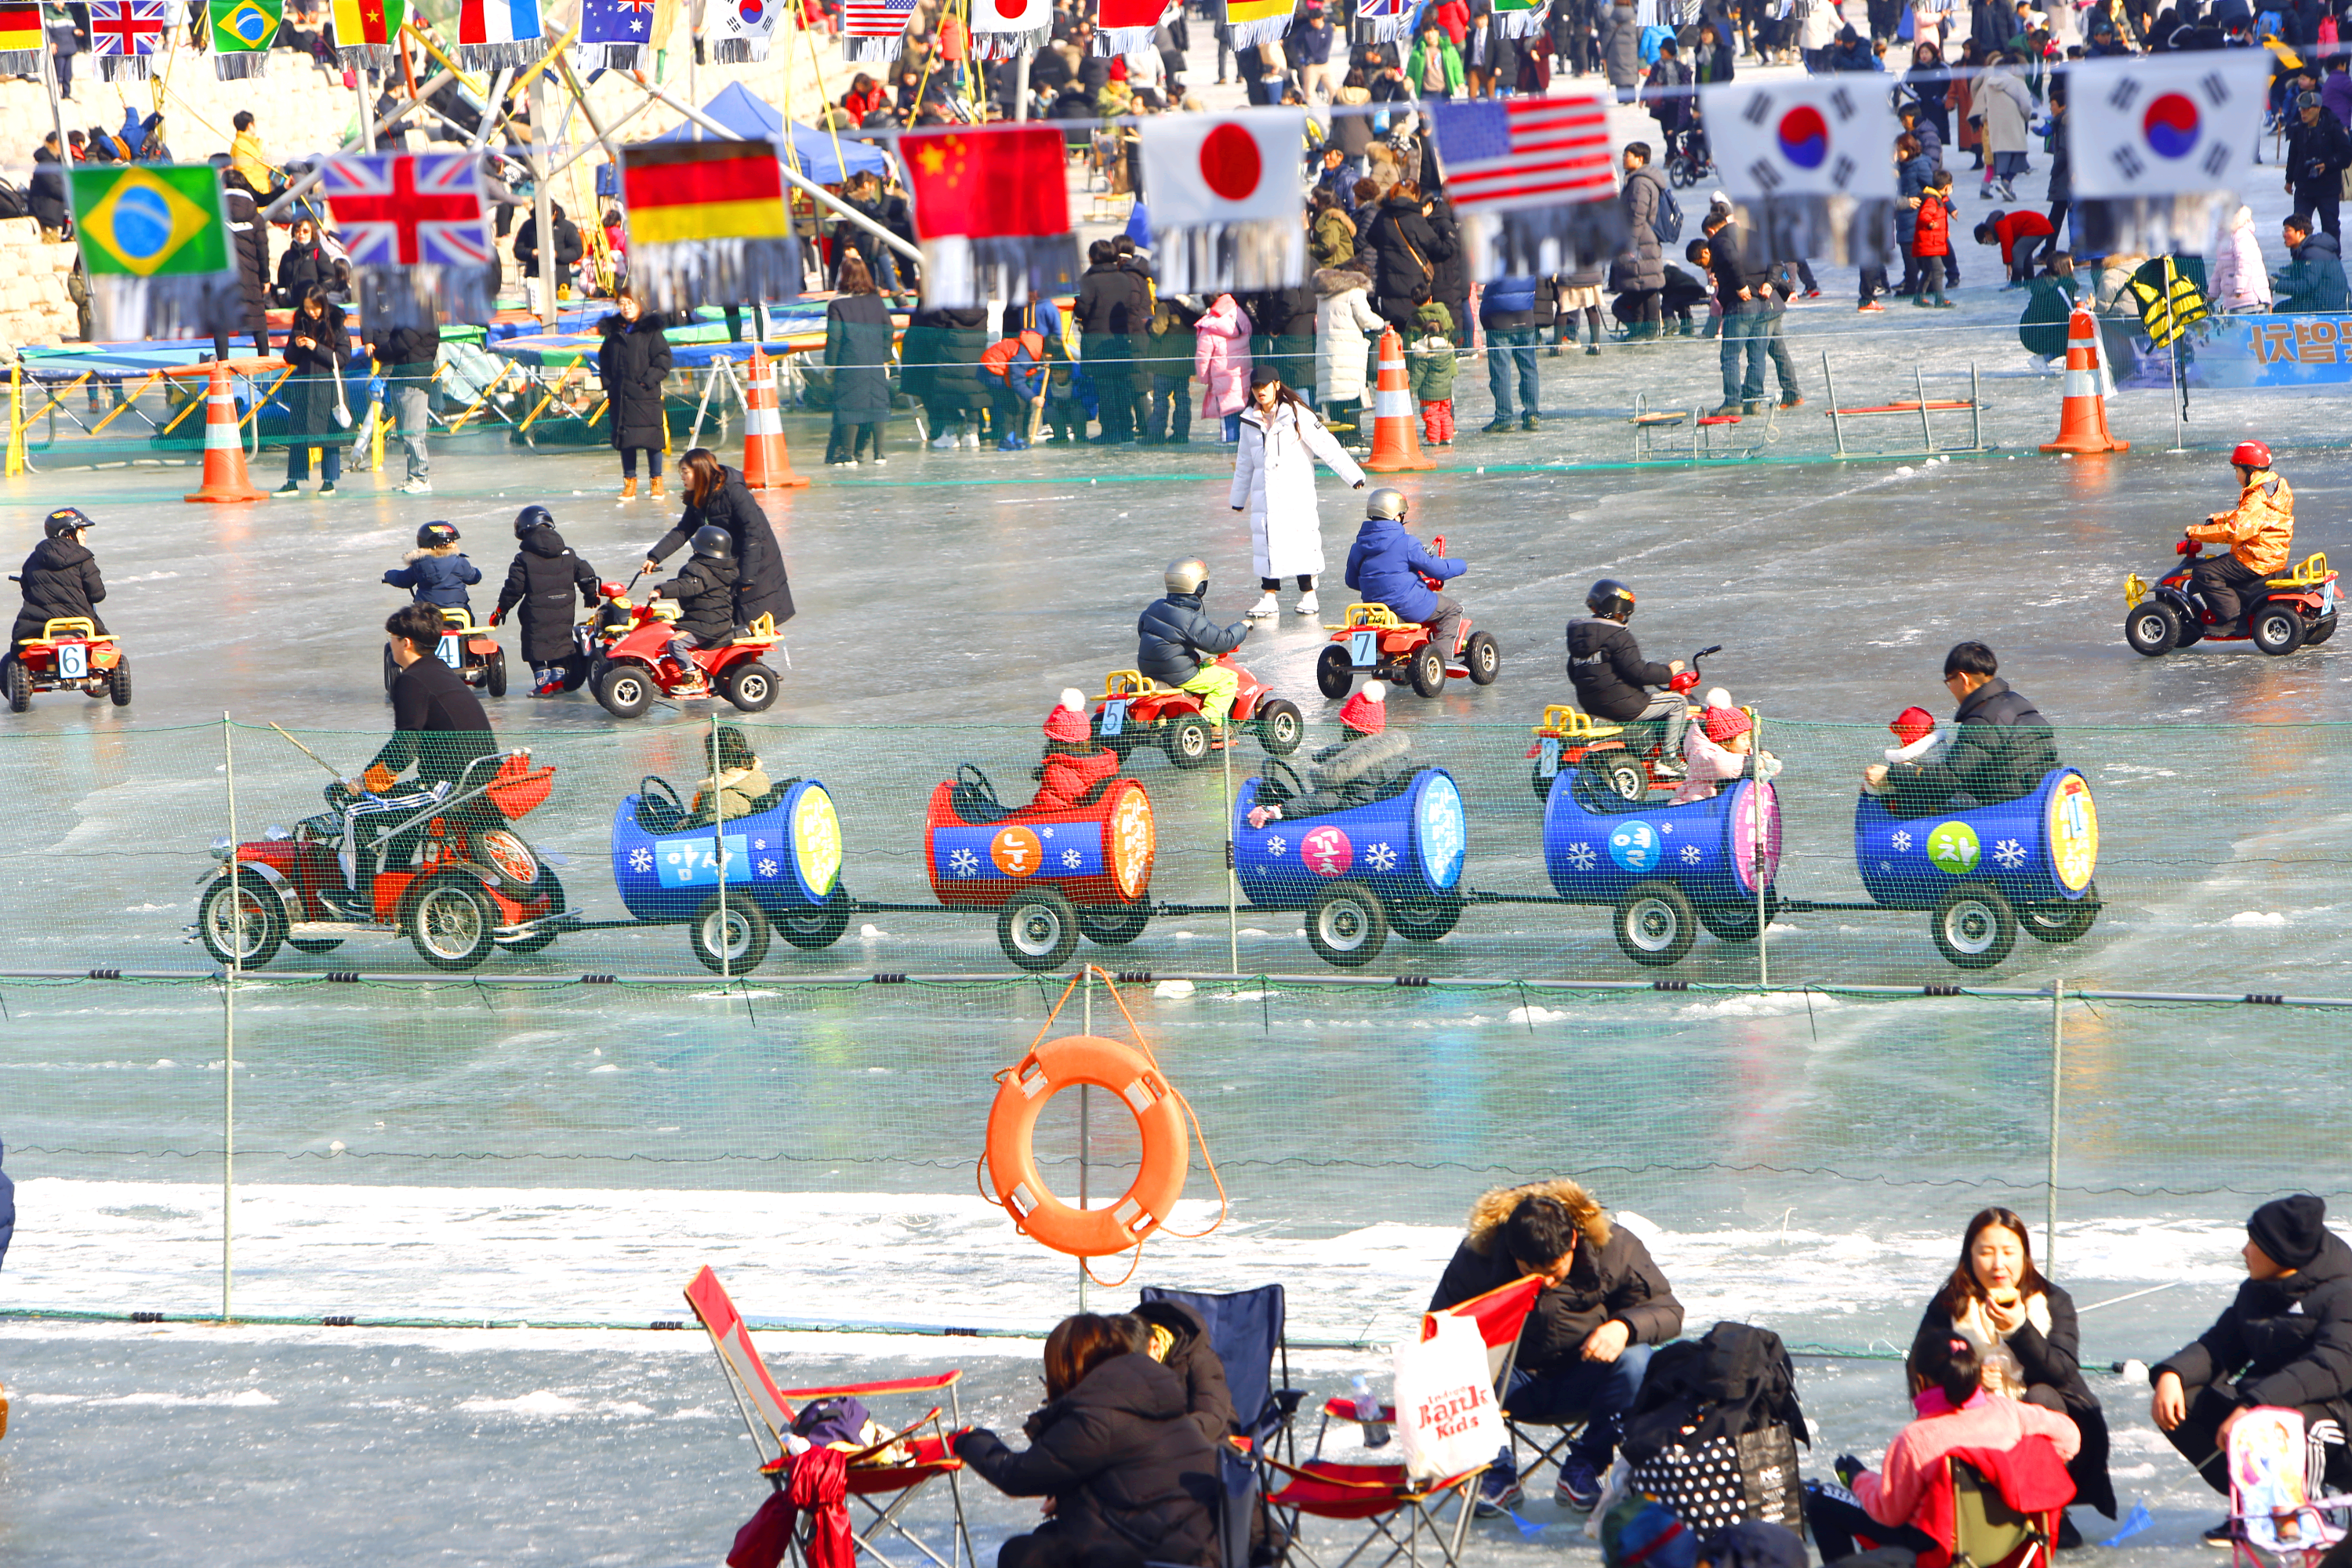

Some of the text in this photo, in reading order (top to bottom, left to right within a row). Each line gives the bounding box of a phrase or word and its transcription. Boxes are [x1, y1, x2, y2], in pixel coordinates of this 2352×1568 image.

[2324, 582, 2332, 611] 9
[62, 646, 80, 674] 6
[436, 637, 454, 664] 4
[1355, 633, 1371, 662] 7
[1104, 702, 1120, 731] 5
[1544, 741, 1554, 774] 8
[1002, 833, 1029, 872] 눈
[1308, 829, 1341, 873] 꽃
[1613, 827, 1651, 867] 열
[1936, 834, 1978, 866] 차
[1436, 1416, 1479, 1441] Kids
